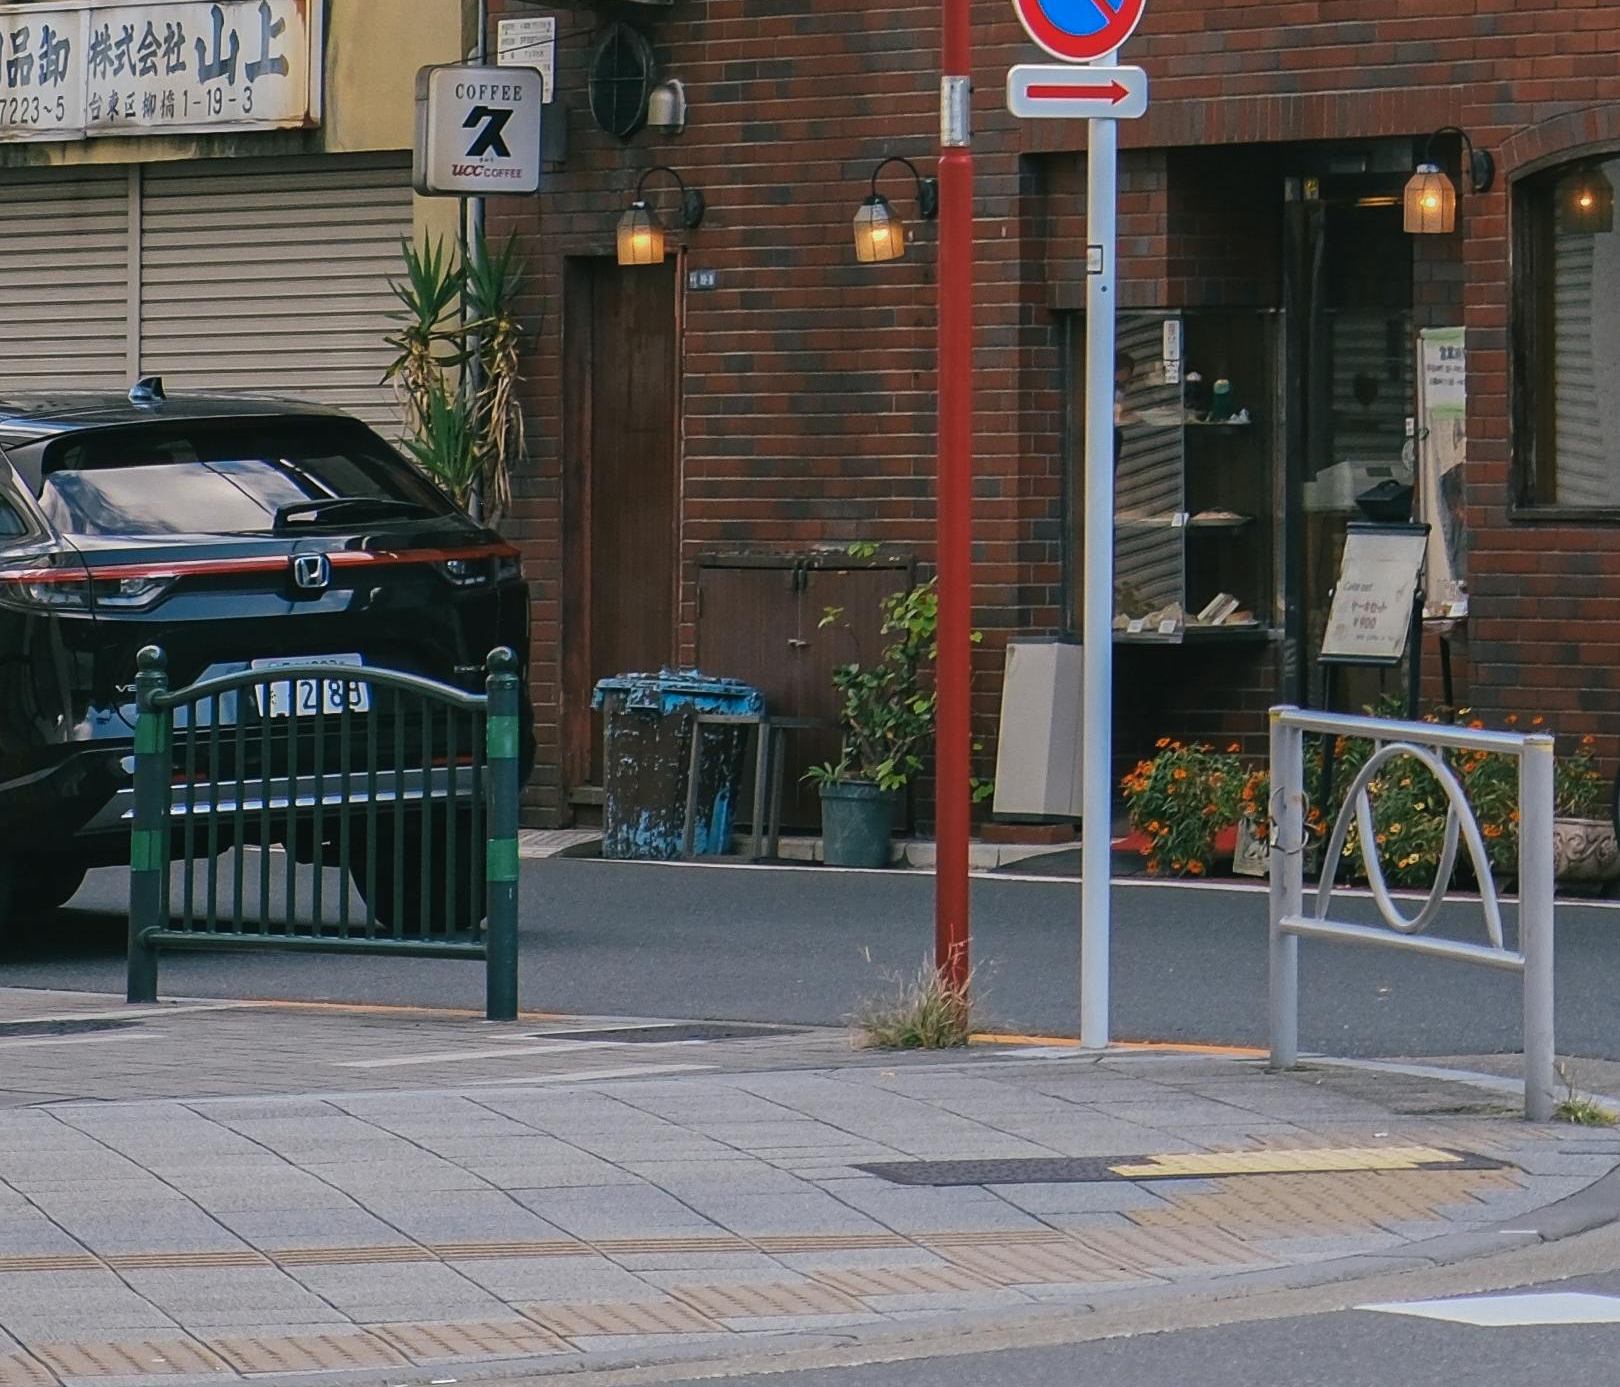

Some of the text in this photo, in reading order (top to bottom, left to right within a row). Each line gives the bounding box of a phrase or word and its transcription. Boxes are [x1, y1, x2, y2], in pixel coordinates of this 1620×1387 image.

[0, 24, 70, 88] 品卸
[455, 83, 523, 102] COFFEE
[483, 167, 522, 178] COFFEE
